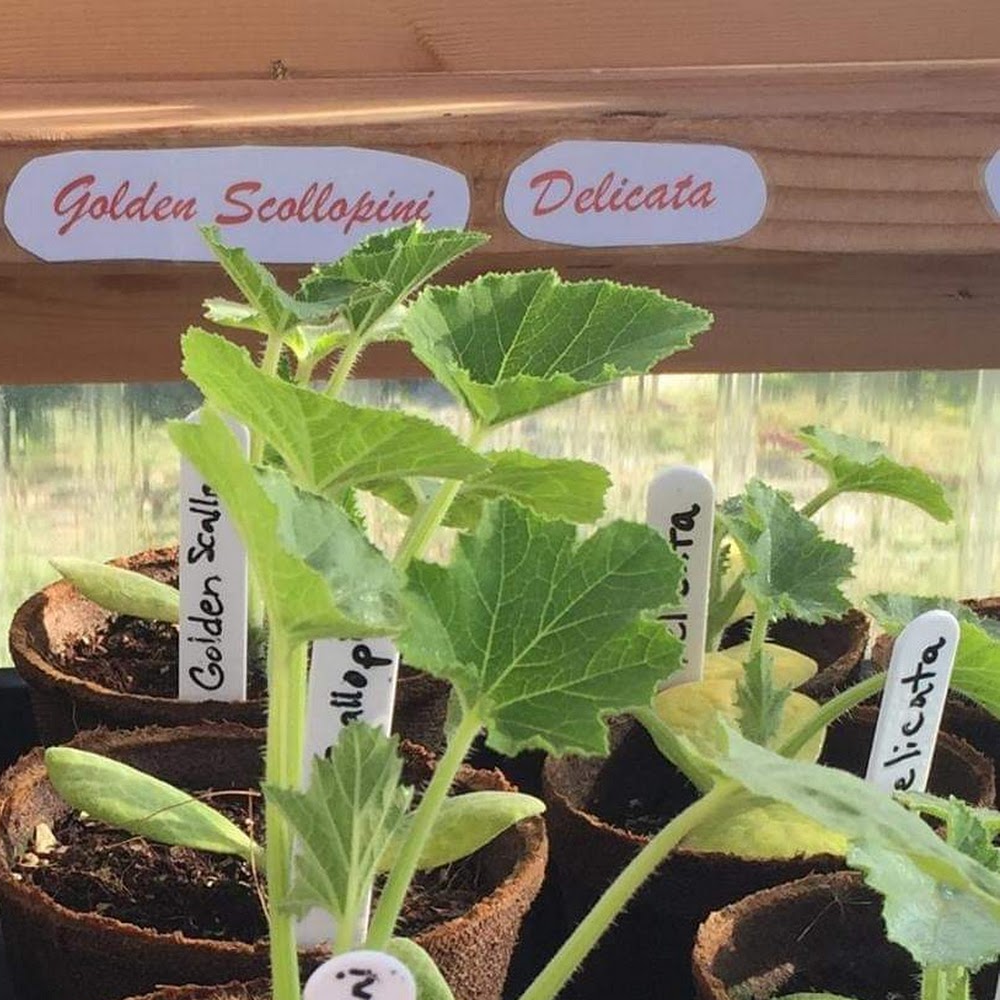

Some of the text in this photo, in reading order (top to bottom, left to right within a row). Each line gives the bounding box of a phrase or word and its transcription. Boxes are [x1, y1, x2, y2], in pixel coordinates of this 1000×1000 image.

[53, 174, 435, 236] Golden Scollopini
[529, 169, 717, 217] Delicata
[884, 637, 946, 791] elicata
